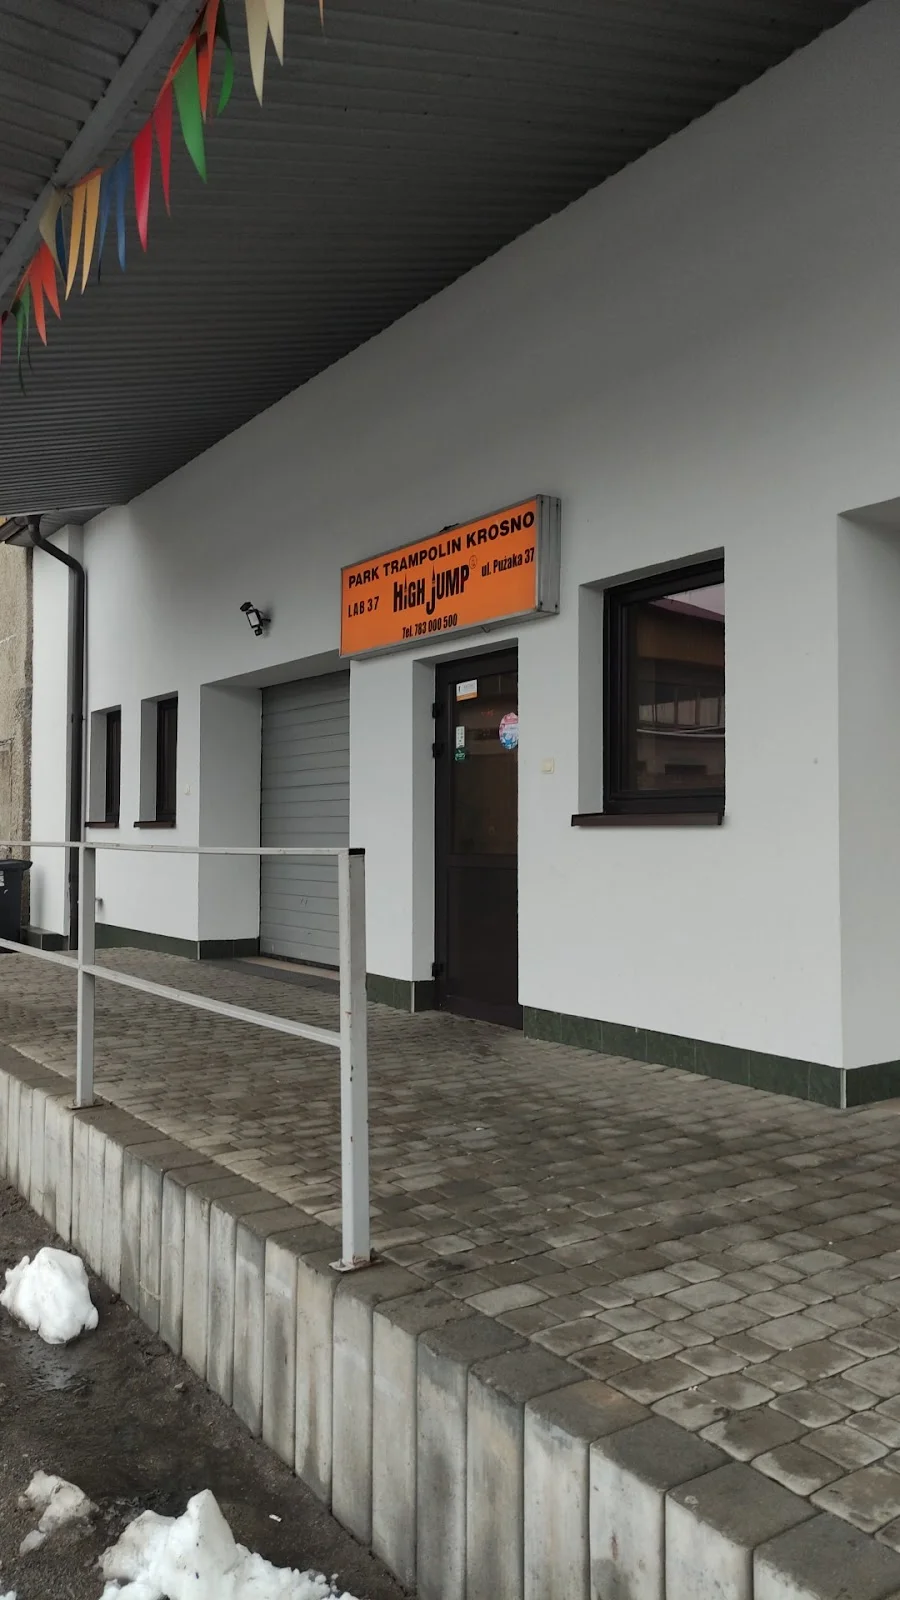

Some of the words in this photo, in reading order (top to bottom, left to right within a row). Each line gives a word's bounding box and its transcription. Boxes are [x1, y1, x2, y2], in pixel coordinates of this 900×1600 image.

[348, 566, 380, 589] PARK
[383, 536, 462, 577] TRAMPOLIN
[466, 511, 535, 548] KROSNO
[481, 562, 491, 577] ul.
[493, 552, 523, 574] Pużaka
[524, 547, 535, 563] 37
[348, 601, 365, 618] LAB
[367, 596, 380, 611] 37
[402, 625, 413, 639] Tel.
[428, 617, 442, 633] 000
[443, 613, 458, 629] 500
